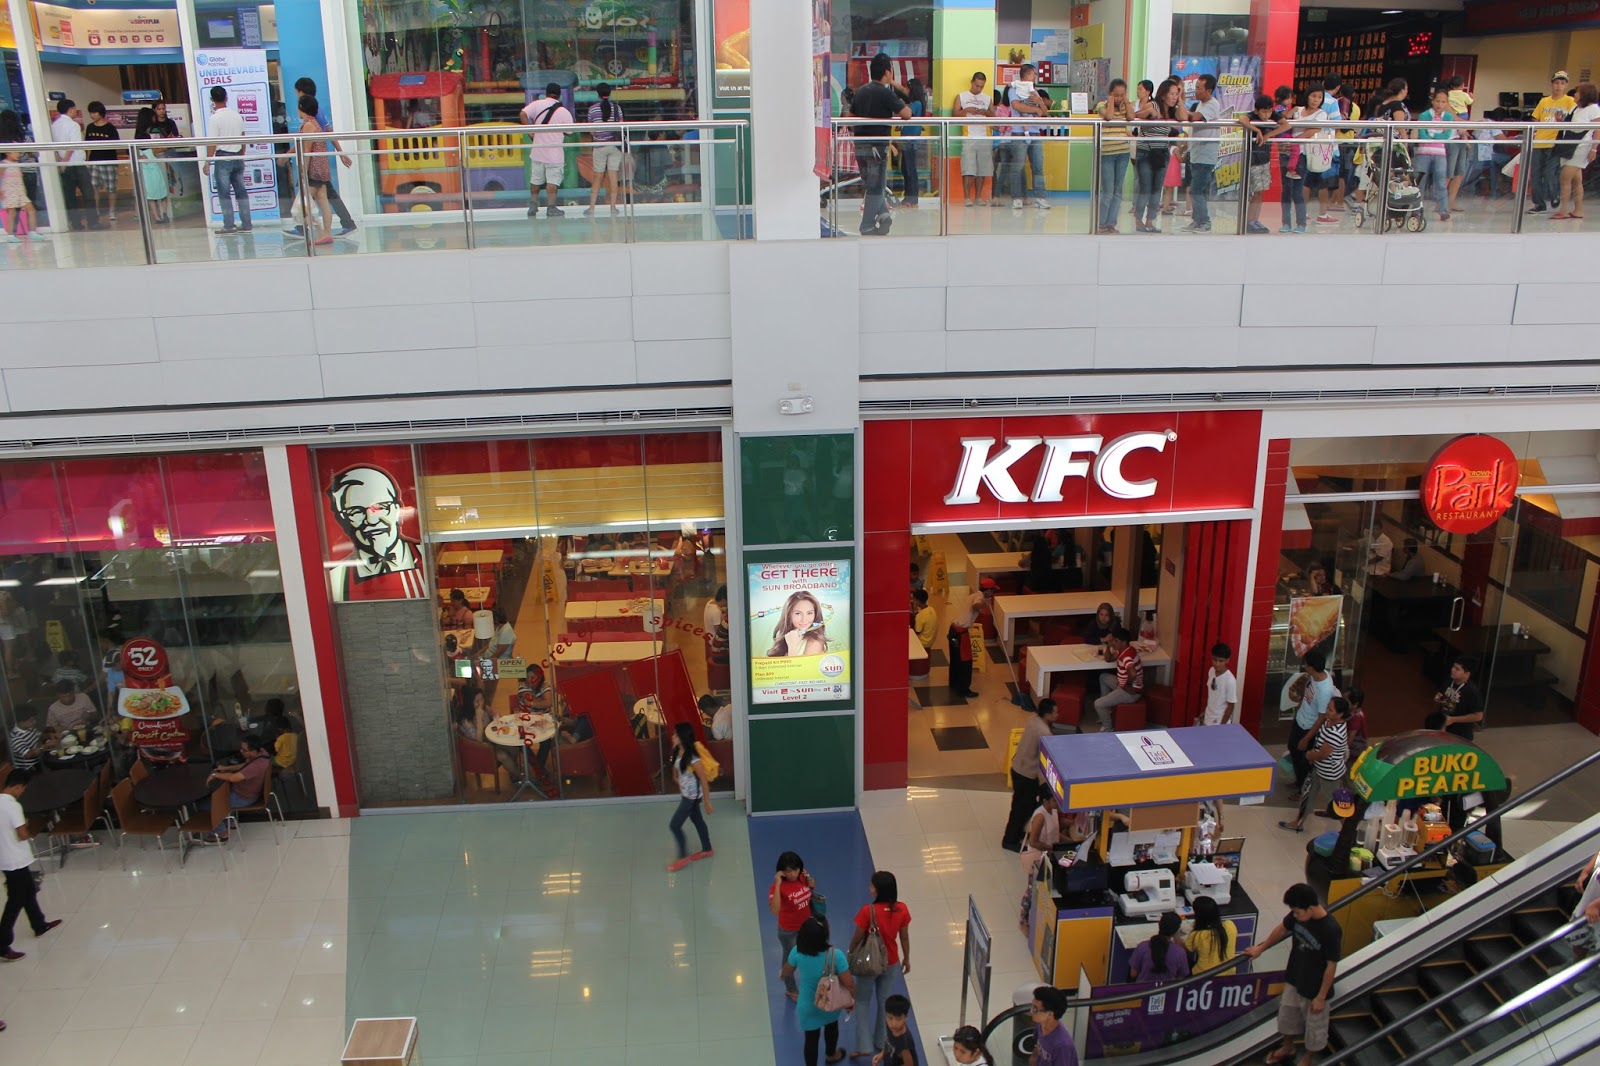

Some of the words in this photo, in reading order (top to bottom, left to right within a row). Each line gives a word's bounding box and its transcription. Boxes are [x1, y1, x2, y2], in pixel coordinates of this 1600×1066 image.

[199, 65, 265, 77] UNBELIEVABLE
[204, 76, 232, 85] DEALS
[1218, 73, 1252, 86] Bingo
[944, 431, 1168, 505] KFC
[1430, 458, 1513, 512] Park
[1436, 510, 1500, 520] RESTAURANT
[761, 569, 788, 580] GET
[792, 568, 838, 578] THERE
[784, 582, 837, 590] BROADBAND
[649, 616, 714, 642] spices
[1413, 752, 1478, 776] BUKO
[1397, 772, 1486, 797] PEARL
